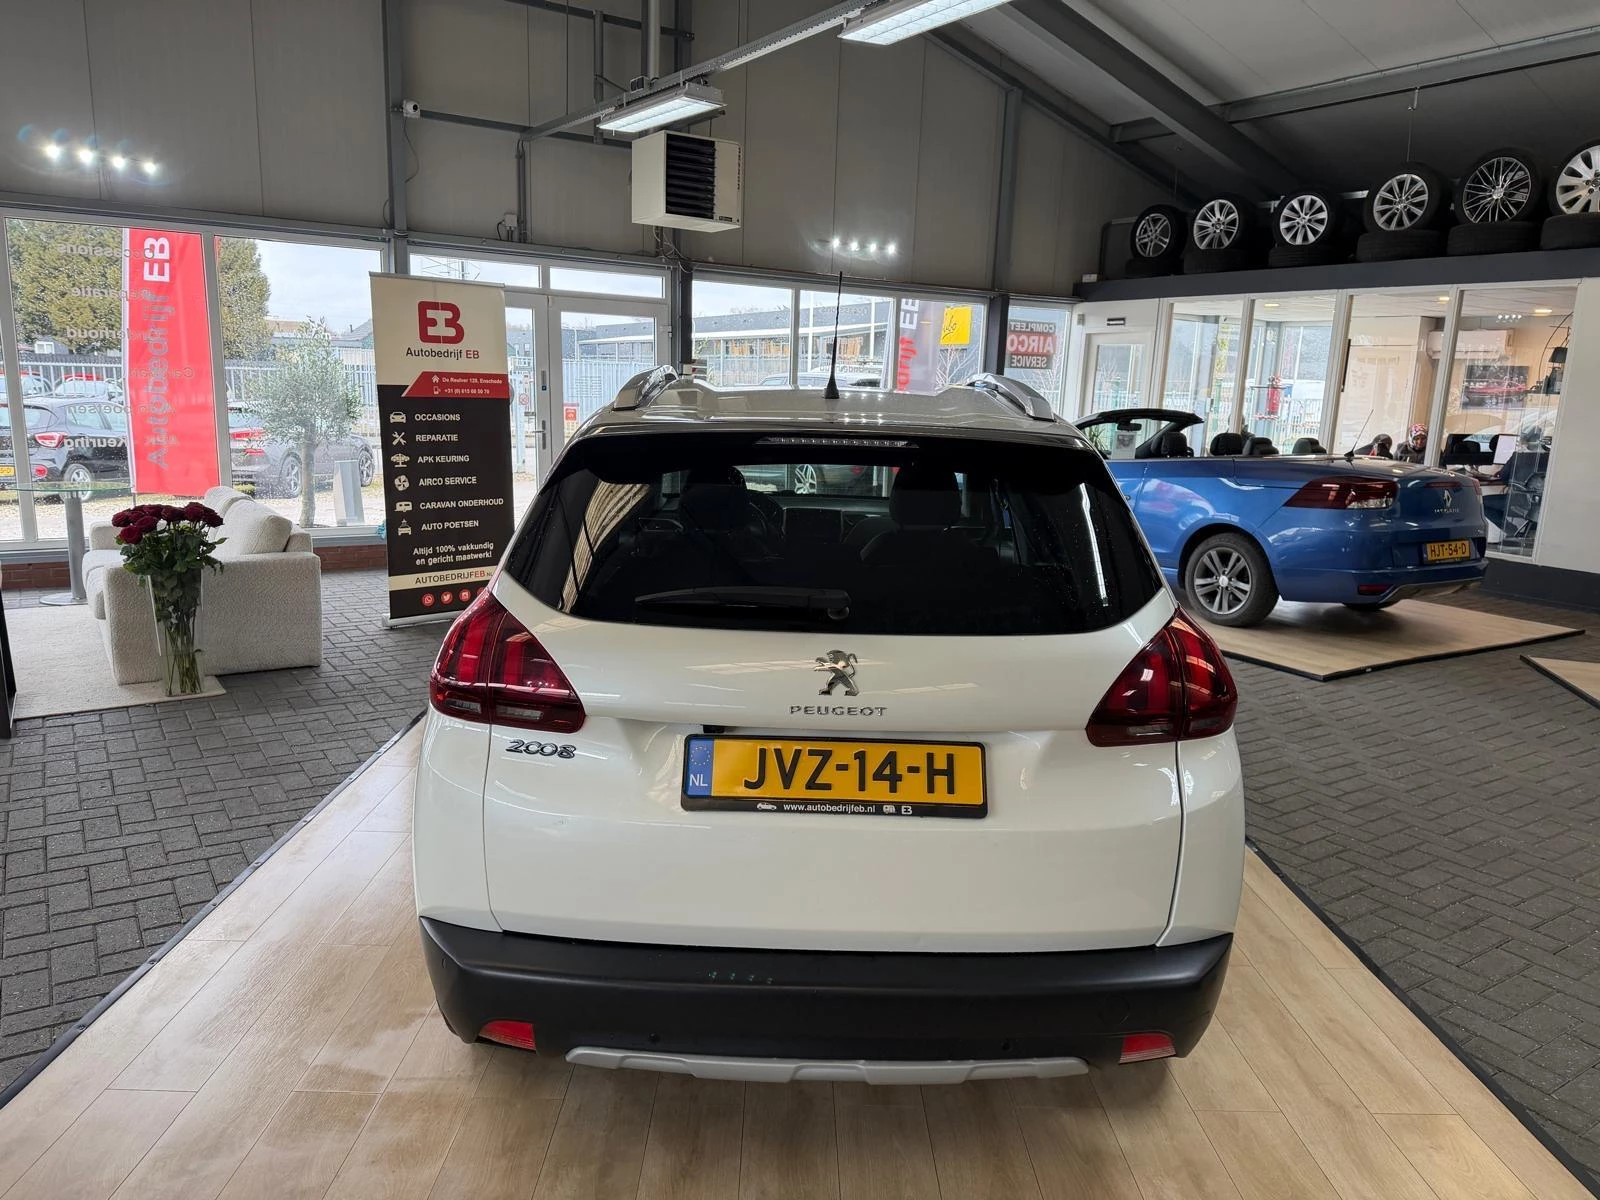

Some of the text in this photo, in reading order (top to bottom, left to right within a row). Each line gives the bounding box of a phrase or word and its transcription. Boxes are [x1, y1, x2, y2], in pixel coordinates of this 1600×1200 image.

[143, 236, 170, 283] EB
[405, 347, 480, 361] Autobedrijf EB
[143, 288, 174, 470] Autobedrijf
[414, 413, 461, 421] OCCASIONS
[415, 434, 459, 442] REPARATIE
[417, 454, 470, 464] APK KEURING
[418, 476, 477, 486] AIRCO SERVICE
[419, 497, 504, 510] CARAVAN ONDERHOUD
[421, 519, 479, 531] AUTO POETSEN
[412, 541, 494, 557] Altijd 100% vakkundig
[1430, 543, 1466, 558] HJT-54-D
[415, 550, 493, 566] en gericht maatwerk!
[789, 705, 888, 717] PEUGEOT
[505, 738, 577, 760] 2008
[689, 747, 956, 796] NL JVZ-14-H
[783, 802, 876, 815] www.autobedrijfeb.nl
